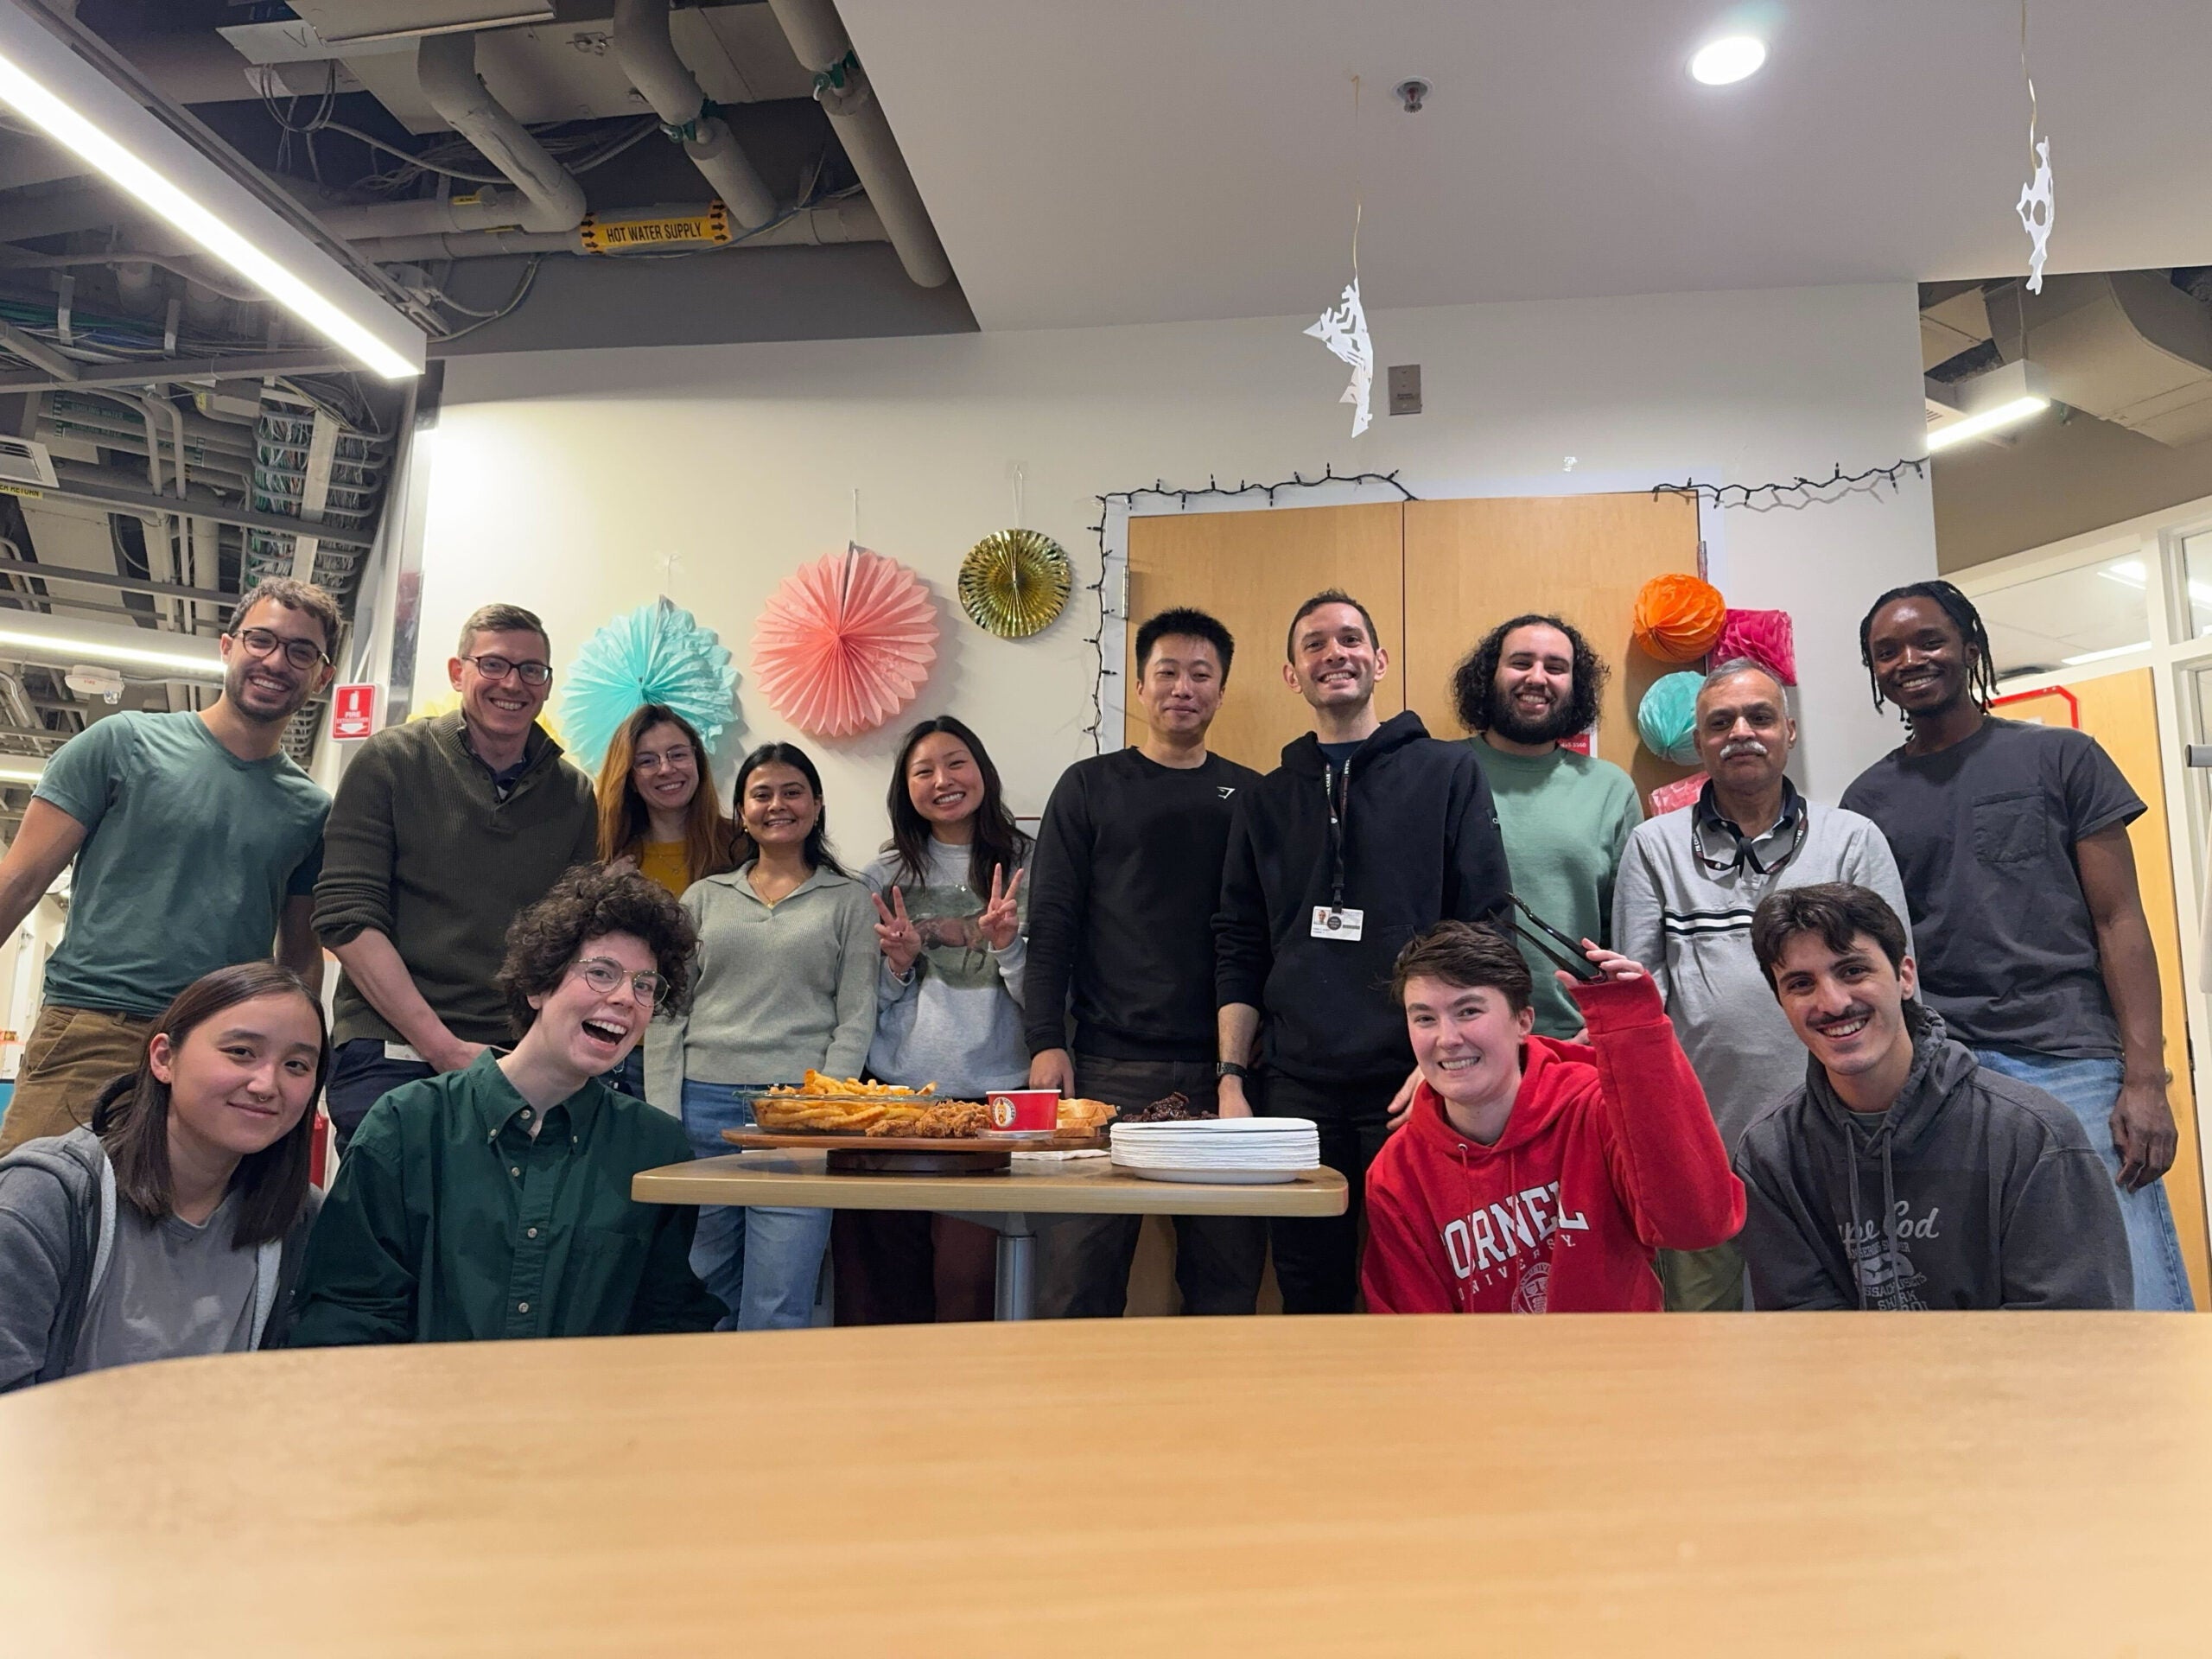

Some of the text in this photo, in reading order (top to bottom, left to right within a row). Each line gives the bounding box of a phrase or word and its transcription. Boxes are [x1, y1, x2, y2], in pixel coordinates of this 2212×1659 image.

[606, 222, 702, 243] HOT WATER SUPPLY
[10, 486, 39, 497] RETURN
[1440, 1180, 1590, 1280] ORNEL
[1458, 1234, 1576, 1300] UNIVERSY
[1878, 1290, 1917, 1311] SHRK
